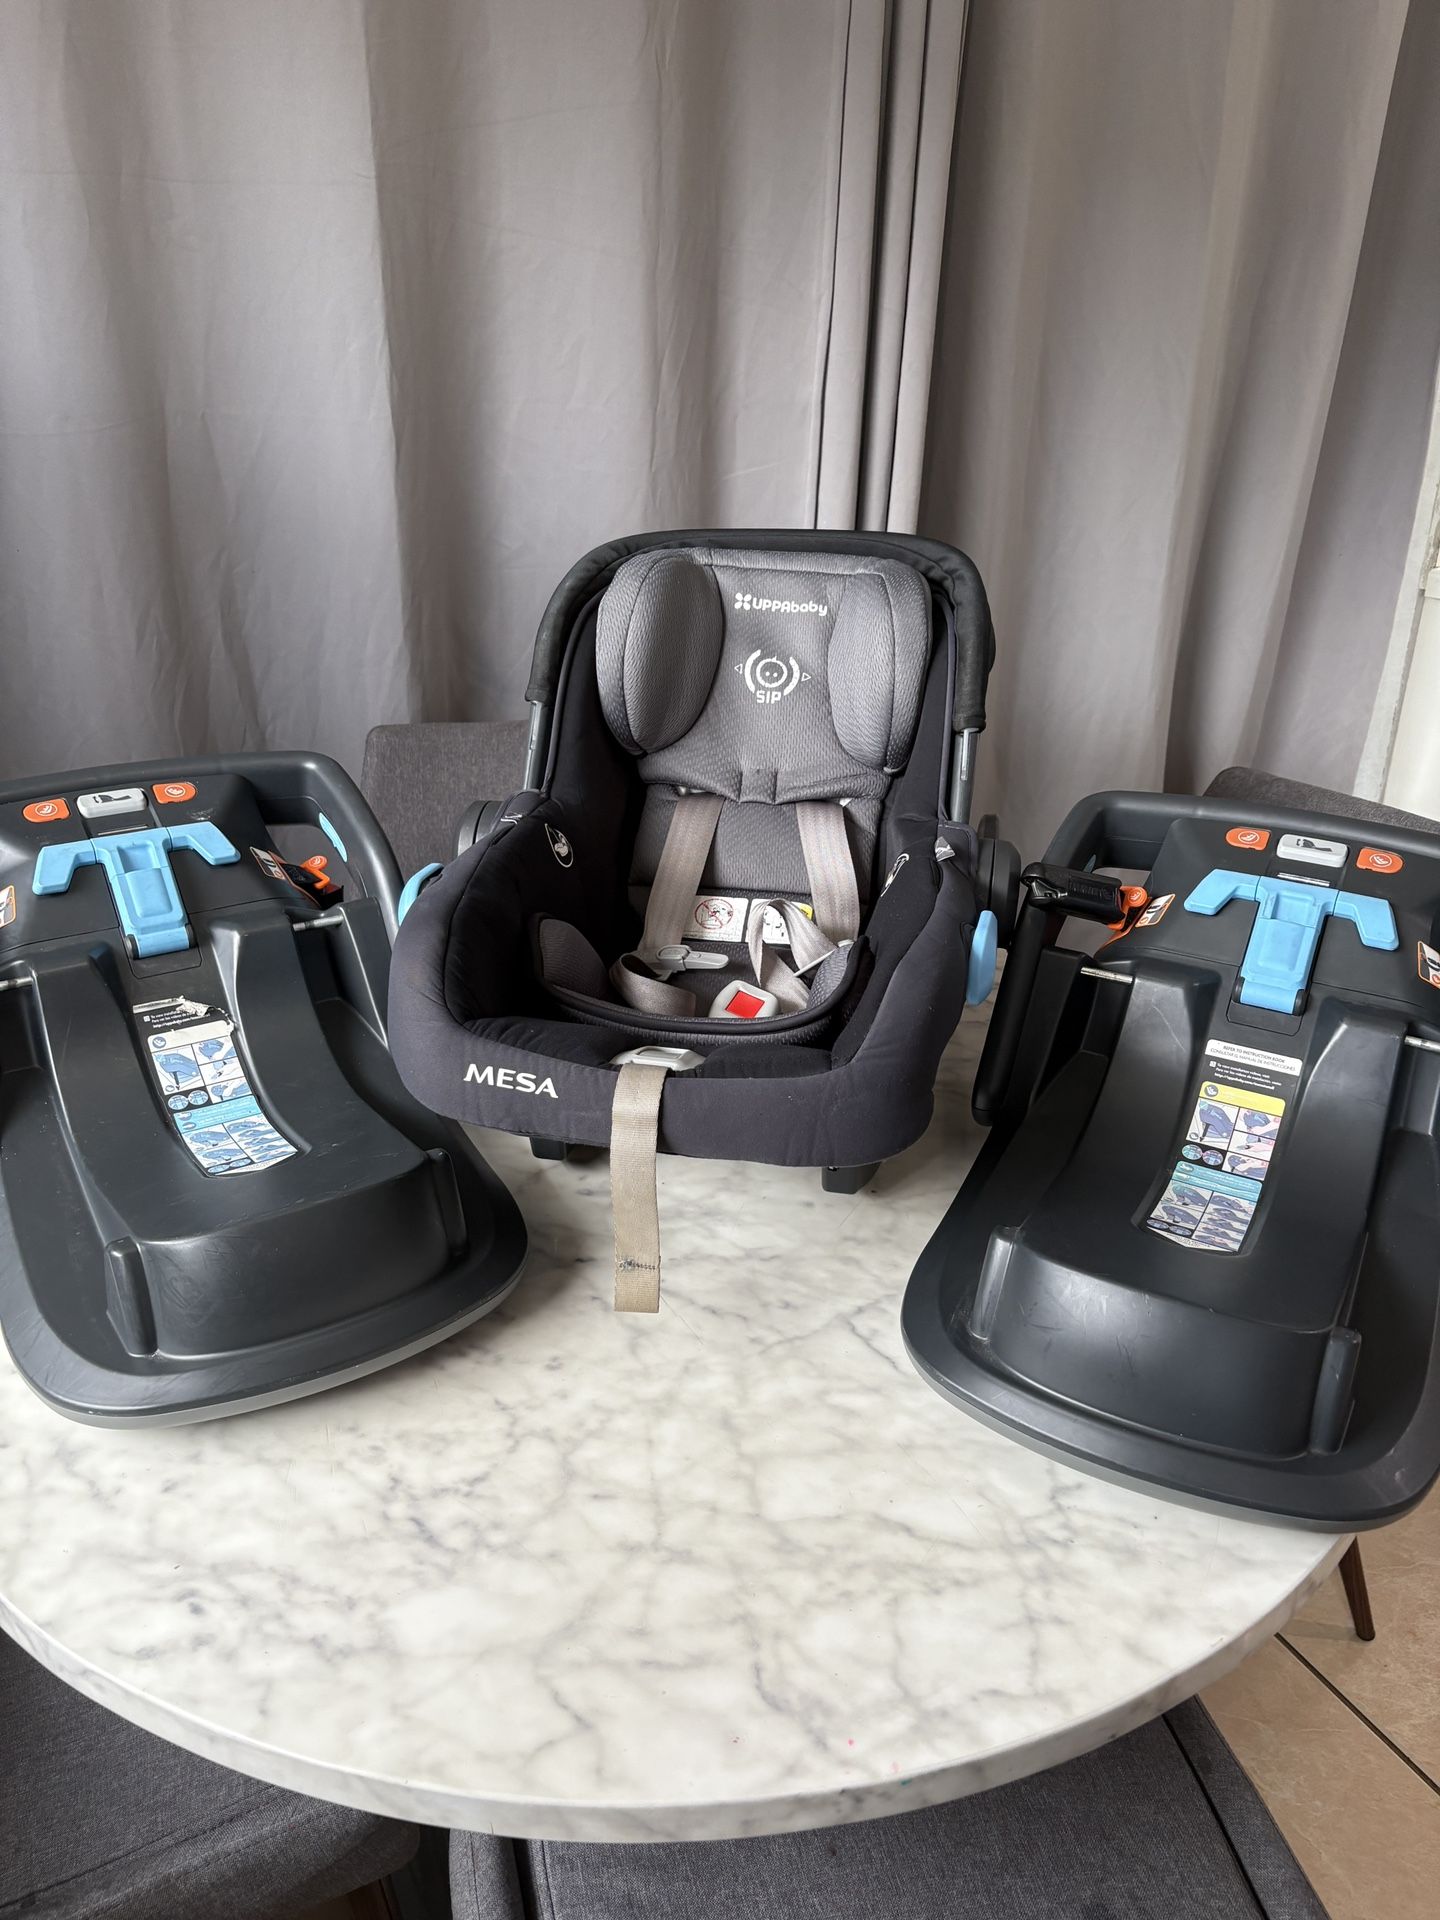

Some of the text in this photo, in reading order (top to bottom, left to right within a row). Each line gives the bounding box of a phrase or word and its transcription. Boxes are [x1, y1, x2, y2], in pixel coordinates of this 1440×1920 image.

[756, 690, 782, 704] SIP
[1243, 1050, 1271, 1060] INSTRUCTION
[463, 1063, 559, 1099] MESA
